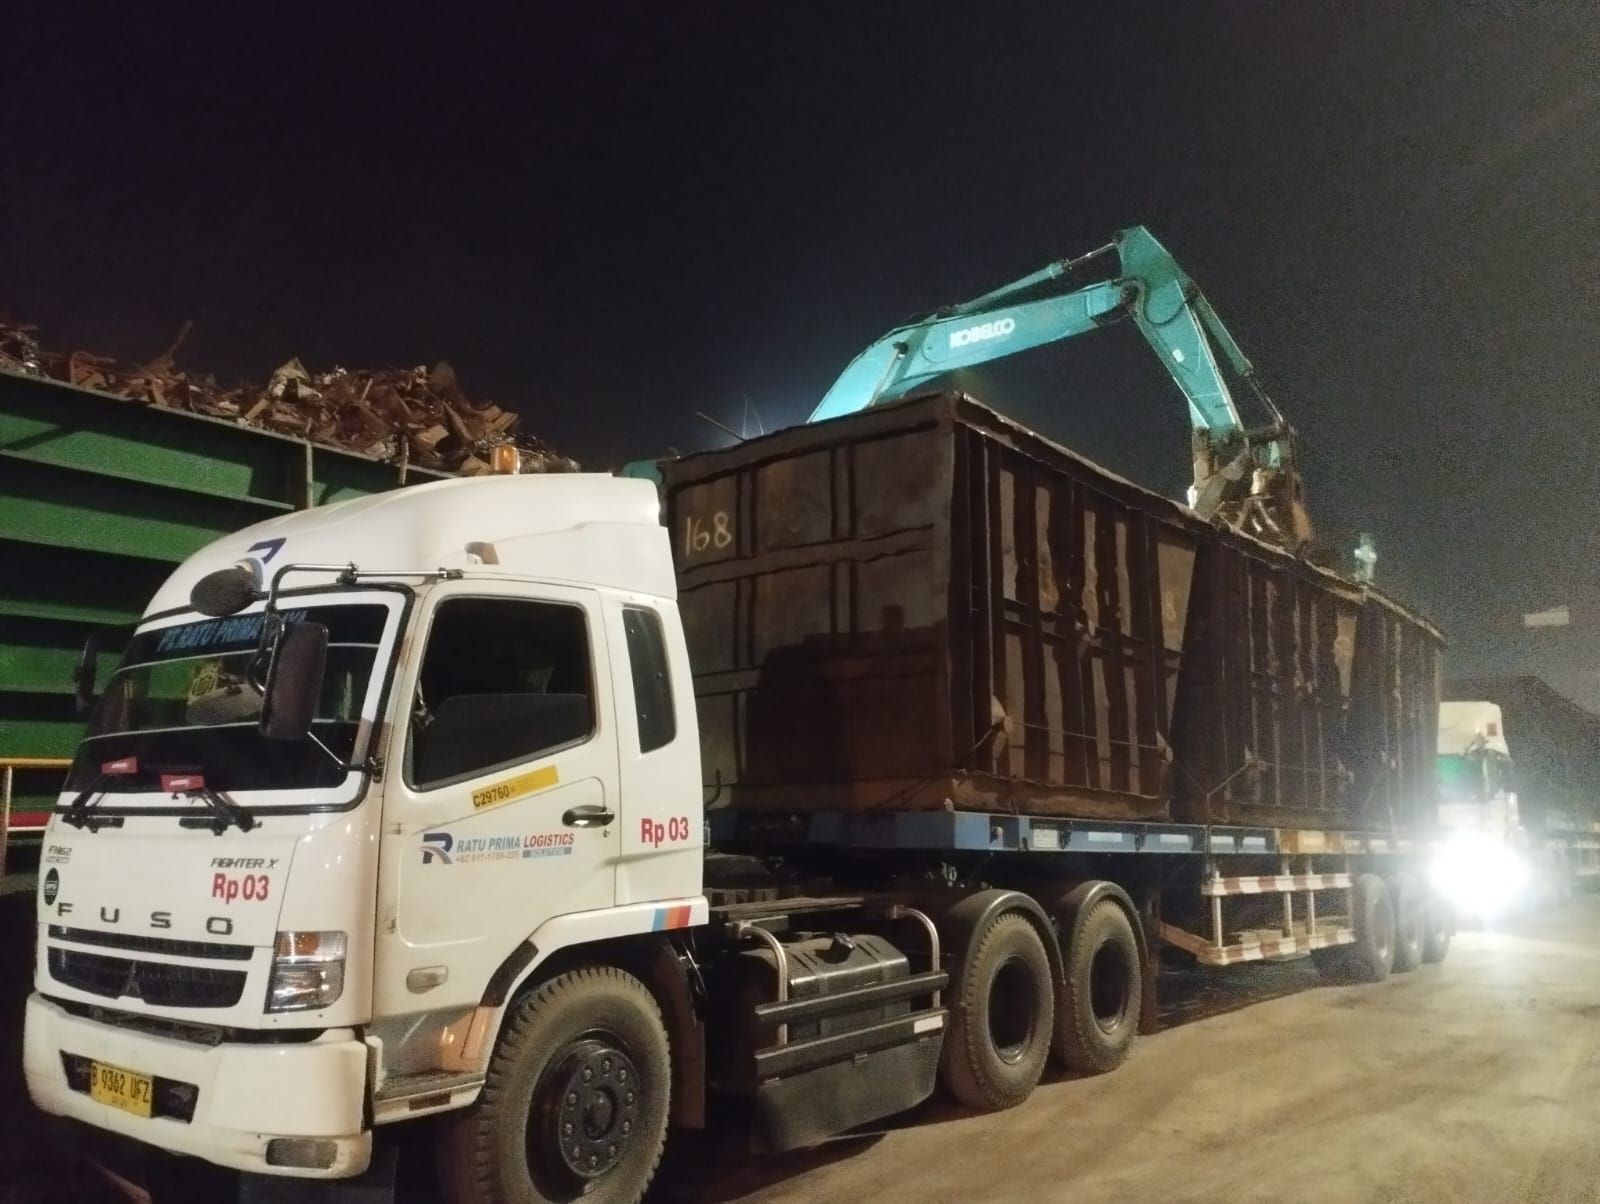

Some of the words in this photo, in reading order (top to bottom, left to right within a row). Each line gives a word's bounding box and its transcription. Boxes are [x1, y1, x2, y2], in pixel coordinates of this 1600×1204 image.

[950, 318, 1015, 348] KOBELCO
[686, 511, 732, 557] 168
[473, 784, 510, 807] C29760
[456, 838, 487, 853] RATU
[488, 836, 521, 851] PRIMA
[523, 833, 575, 848] LOGISTICS
[640, 818, 664, 848] Rp
[669, 817, 689, 841] 03
[210, 857, 265, 868] FIGHTER
[268, 858, 280, 869] X
[212, 873, 239, 904] Rp
[242, 874, 270, 901] 03
[57, 902, 233, 935] FUSO
